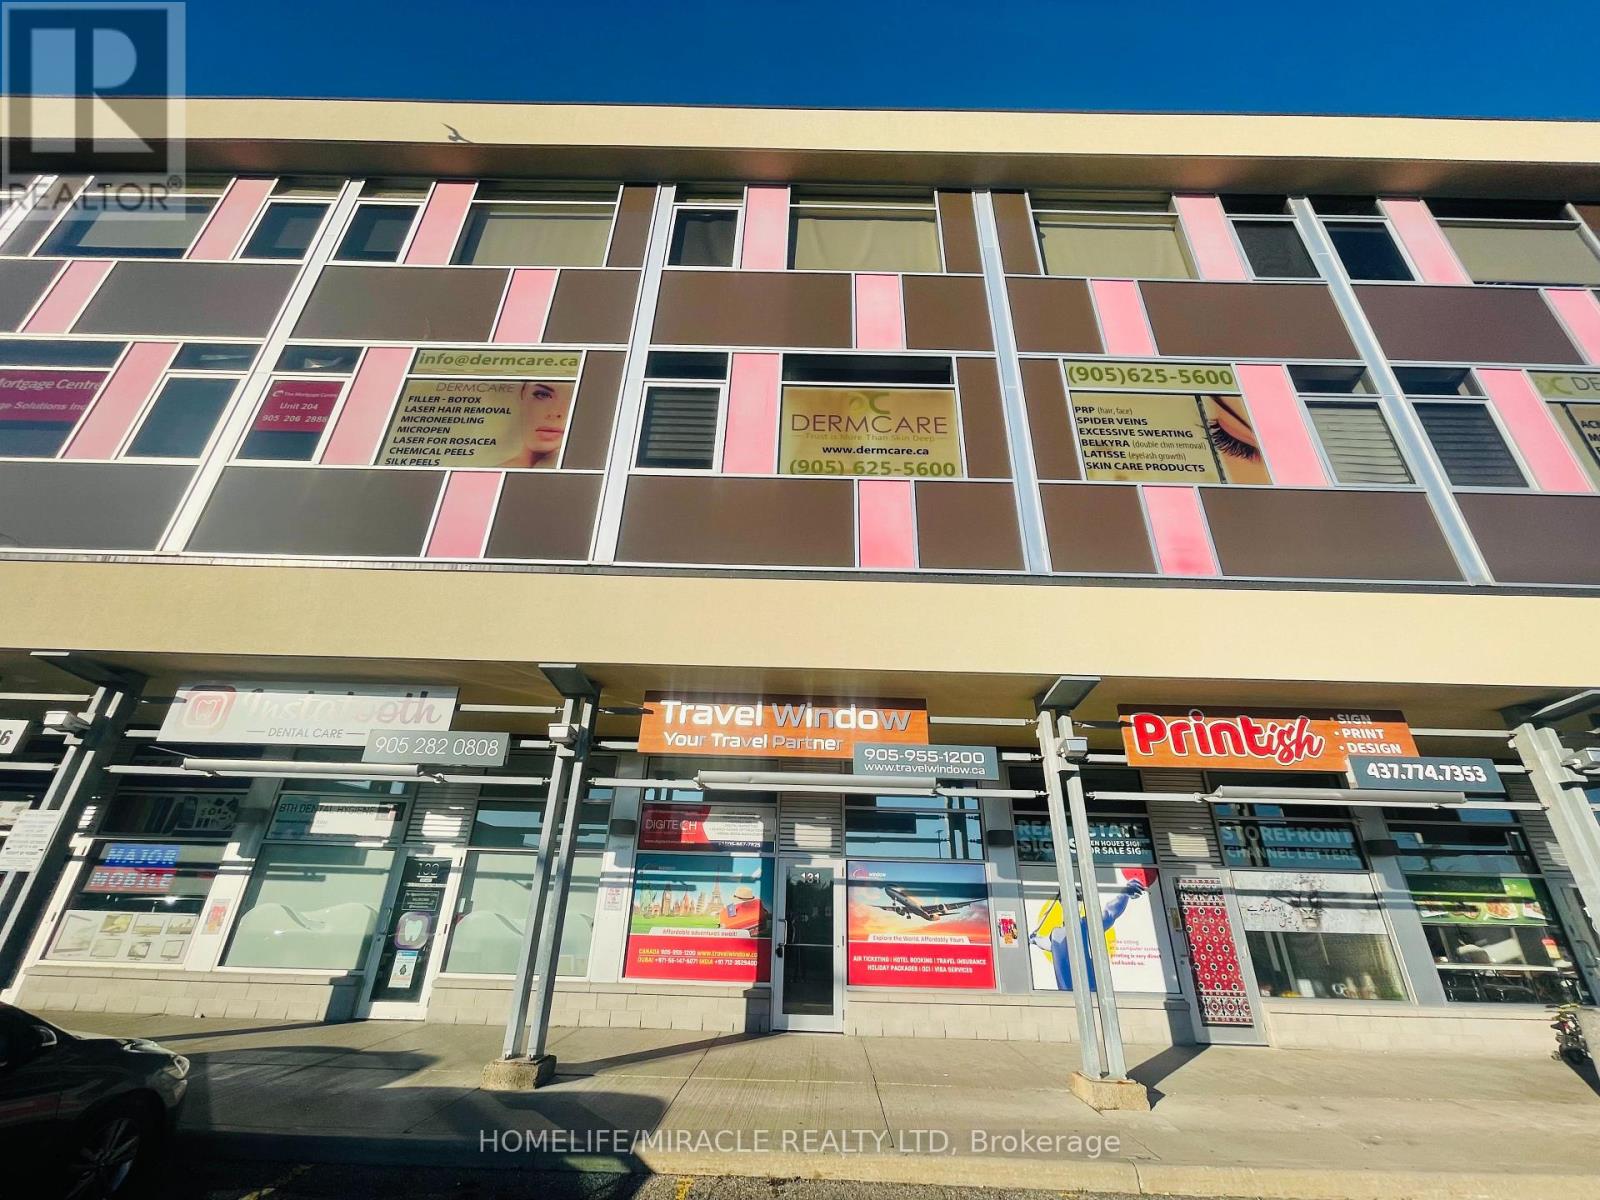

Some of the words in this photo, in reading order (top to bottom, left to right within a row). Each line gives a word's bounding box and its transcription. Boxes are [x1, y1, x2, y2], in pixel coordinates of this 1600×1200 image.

[418, 352, 578, 367] info@dermcare.ca
[1068, 366, 1234, 385] (905)625-5600
[436, 382, 515, 393] DERMCARE
[408, 395, 440, 403] FILLER
[448, 396, 482, 404] BOTOX
[15, 401, 68, 411] Solutions
[280, 402, 300, 410] Unit
[404, 405, 435, 413] LASER
[437, 406, 462, 414] HAIR
[464, 407, 512, 415] REMOVAL
[1075, 406, 1095, 414] PRP
[262, 414, 279, 422] 905
[401, 416, 485, 424] MICRONEEDLING
[1077, 417, 1115, 425] SPIDER
[1116, 418, 1148, 426] VEINS
[791, 414, 948, 434] DERMCARE
[397, 426, 450, 434] MICROPEN
[1079, 428, 1136, 437] EXCESSIVE
[1138, 429, 1193, 438] SWEATING
[426, 437, 448, 445] FOR
[449, 438, 496, 446] ROSACEA
[1081, 439, 1130, 447] BELKYRA
[389, 447, 442, 455] CHEMICAL
[443, 448, 475, 456] PEELS
[822, 445, 929, 456] www.dermcare.ca
[1084, 450, 1126, 458] LATISSE
[385, 458, 407, 466] SILK
[408, 458, 440, 466] PEELS
[1086, 461, 1111, 470] SKIN
[1114, 462, 1144, 470] CARE
[1145, 463, 1205, 472] PRODUCTS
[790, 459, 844, 475] (905)
[853, 461, 956, 477] 625-5600
[660, 699, 763, 727] Travel
[772, 702, 911, 731] Window
[1337, 713, 1373, 725] SIGN
[268, 728, 309, 738] DENTAL
[312, 728, 344, 739] CARE
[1131, 709, 1326, 767] Printish
[1343, 728, 1385, 740] PRINT
[375, 737, 410, 755] 905
[413, 738, 448, 756] 282
[453, 739, 499, 758] 0808
[663, 732, 704, 748] Your
[711, 733, 768, 749] Travel
[773, 736, 845, 752] Partner
[1347, 742, 1402, 755] DESIGN
[864, 748, 985, 764] 905-955-1200
[864, 762, 986, 776] www.travelwindow.ca
[1367, 763, 1487, 783] 437.774.7353
[646, 819, 697, 831] DIGITECH
[1089, 823, 1146, 838] STATE
[1222, 826, 1355, 843] STOREFRONT
[1101, 847, 1125, 855] SALE
[1227, 846, 1298, 859] CHANNEL
[1300, 848, 1360, 861] LETTERS
[90, 872, 174, 888] MOBILE
